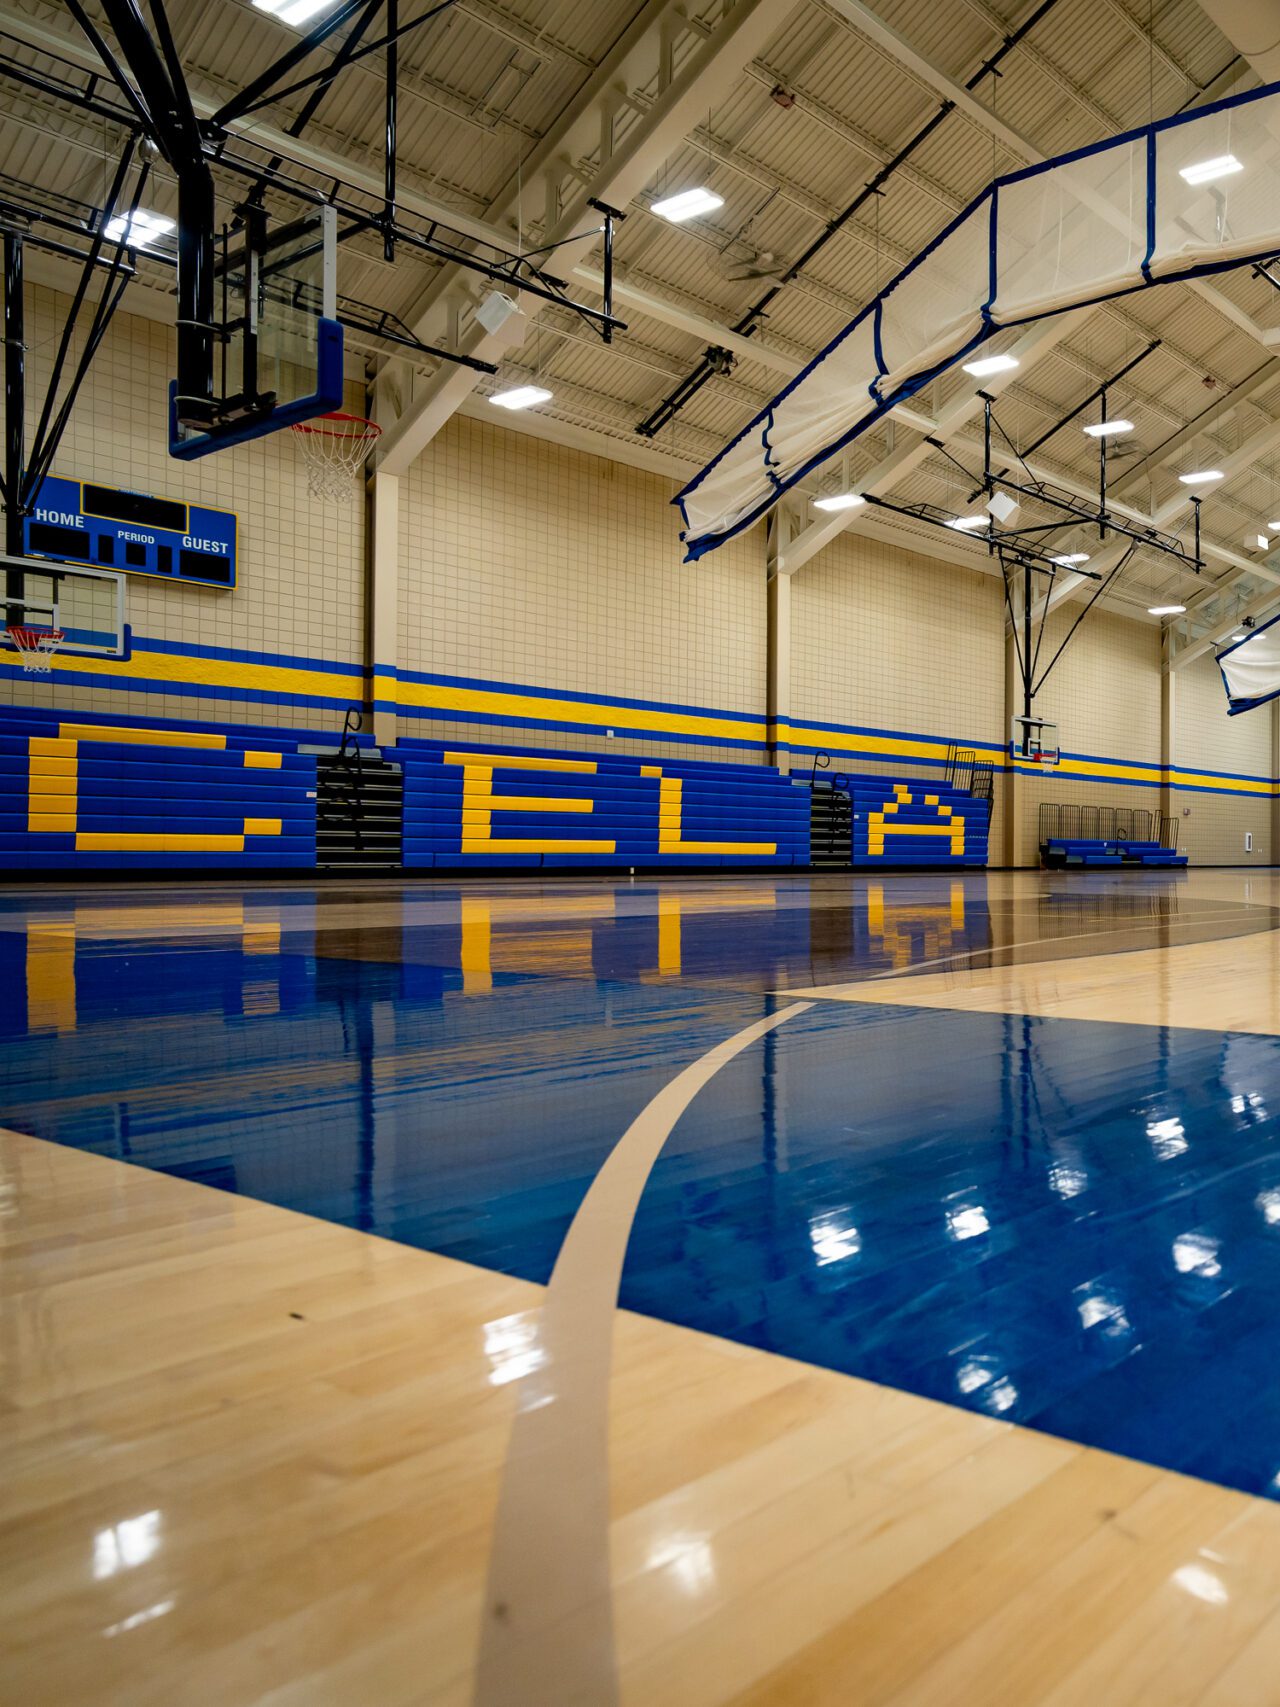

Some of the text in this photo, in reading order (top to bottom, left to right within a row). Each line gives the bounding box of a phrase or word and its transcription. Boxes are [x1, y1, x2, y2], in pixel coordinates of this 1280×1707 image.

[36, 508, 85, 529] HOME
[117, 530, 155, 545] PERIOD
[182, 536, 229, 554] GUEST
